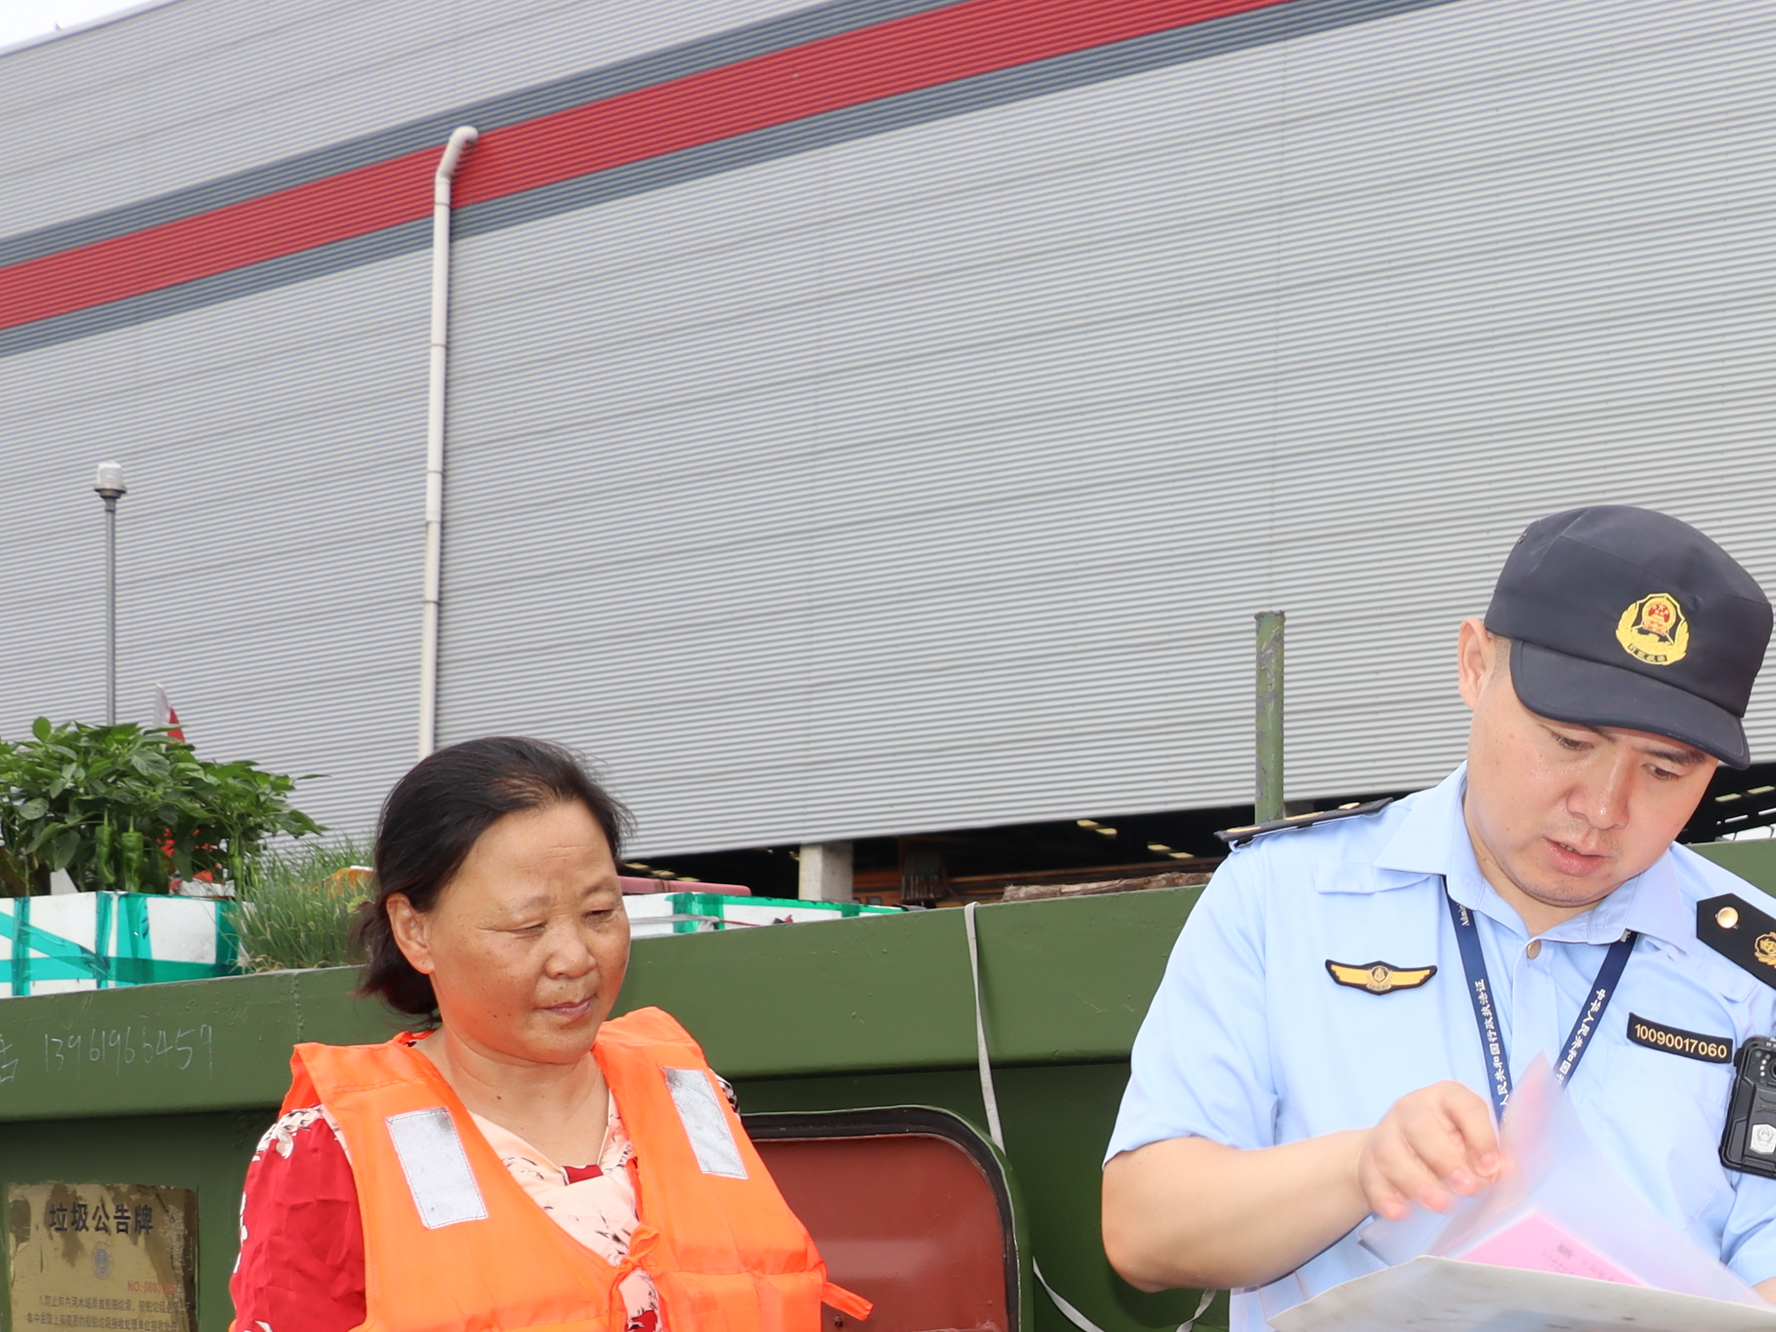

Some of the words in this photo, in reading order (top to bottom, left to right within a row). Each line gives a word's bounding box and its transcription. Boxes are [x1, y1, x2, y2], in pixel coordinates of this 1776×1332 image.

[1634, 1023, 1728, 1059] 10090017060
[49, 1202, 154, 1235] 垃圾公告牌
